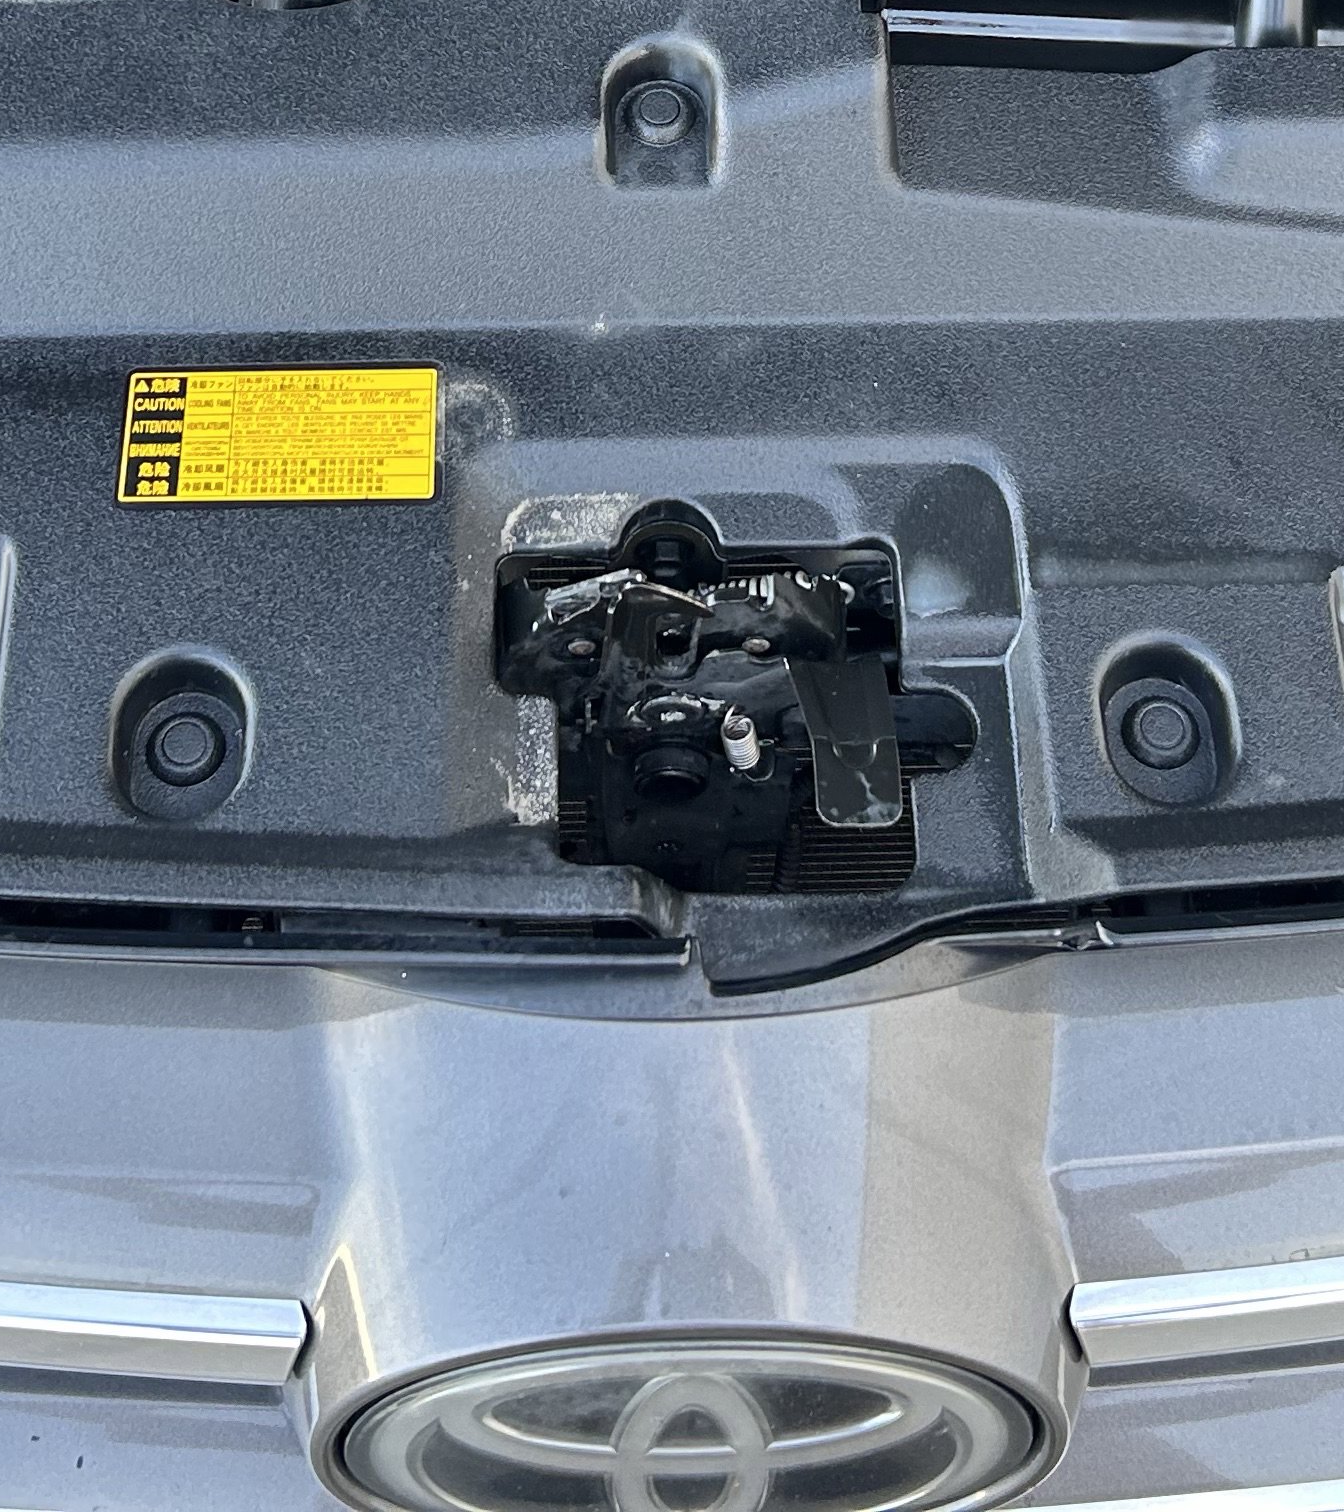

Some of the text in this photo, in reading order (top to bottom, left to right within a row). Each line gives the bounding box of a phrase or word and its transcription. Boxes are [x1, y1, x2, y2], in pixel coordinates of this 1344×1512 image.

[134, 397, 186, 412] CAUTION
[131, 420, 184, 434] ATTENTION
[129, 442, 181, 458] ВНИМАНИЕ
